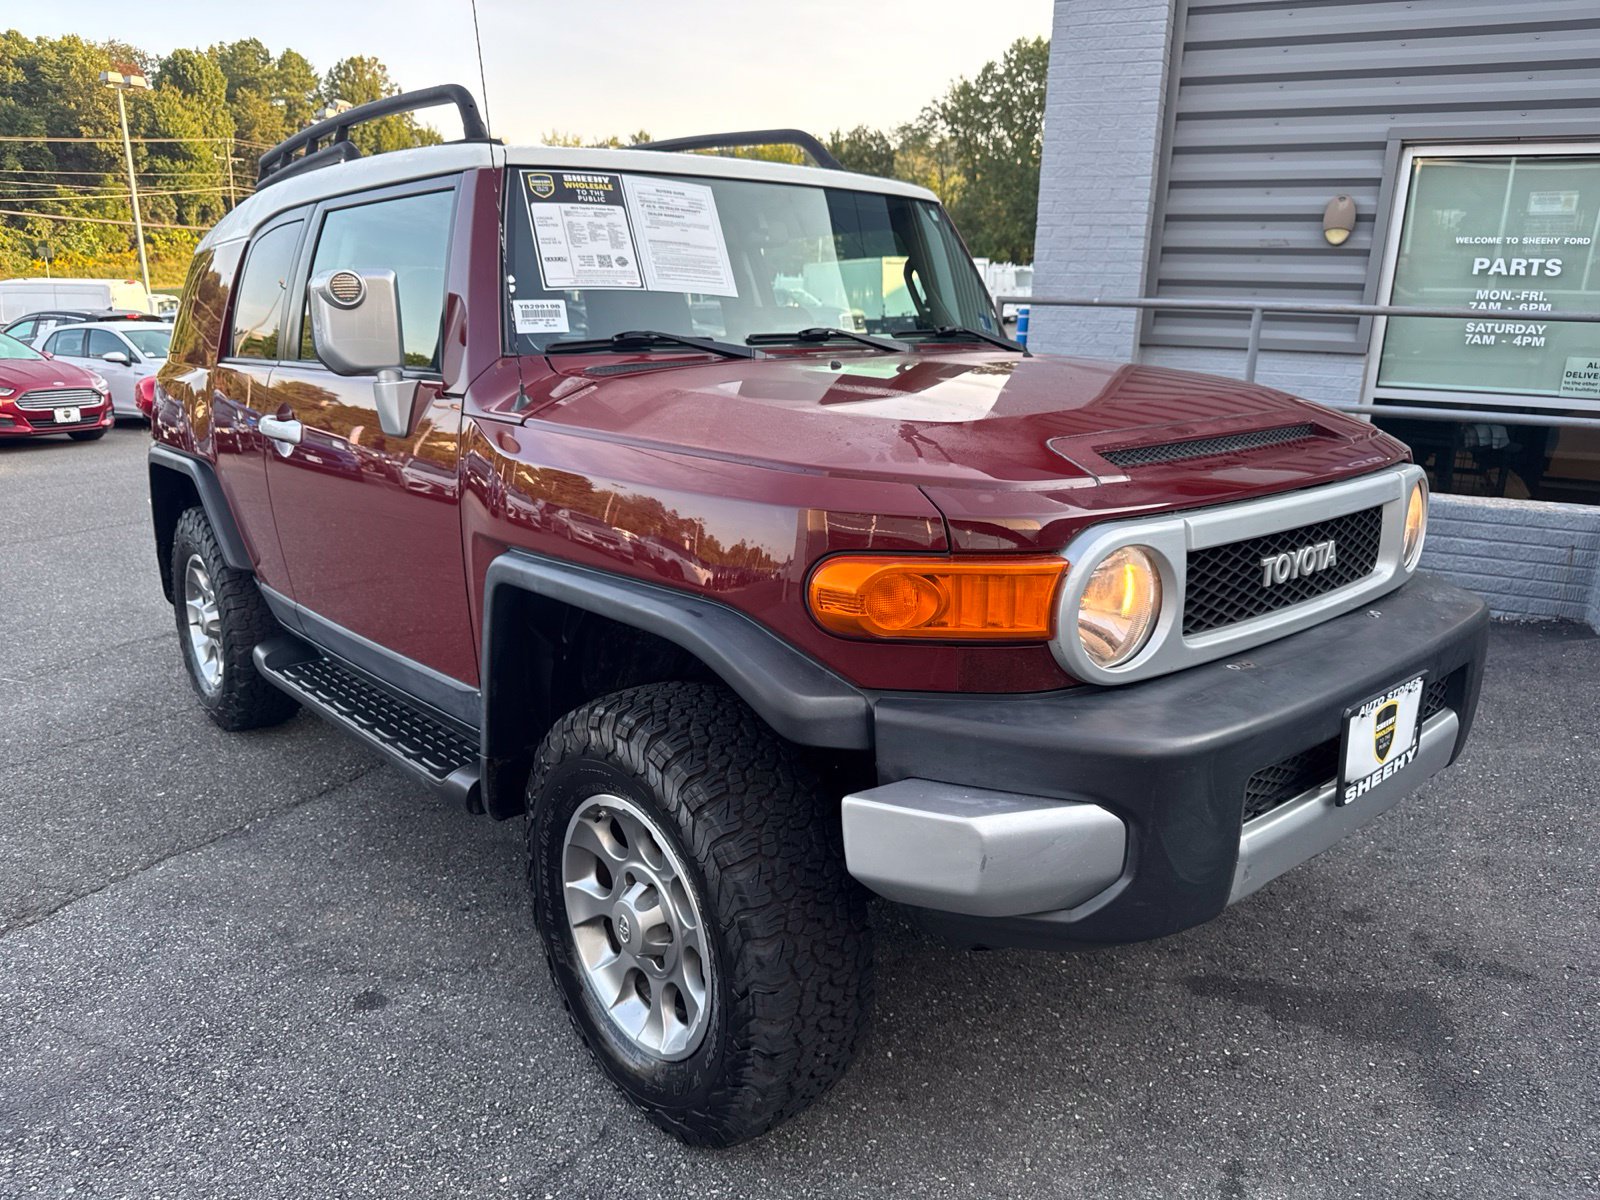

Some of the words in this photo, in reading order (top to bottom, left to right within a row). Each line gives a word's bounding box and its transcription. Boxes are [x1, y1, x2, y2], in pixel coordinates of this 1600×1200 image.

[563, 174, 609, 183] SHEEHY
[564, 182, 613, 191] WHOLESALE
[1456, 236, 1502, 244] WELCOME
[1522, 236, 1560, 244] SHEEHY
[1564, 237, 1591, 245] FORD
[1472, 257, 1562, 276] PARTS
[1469, 302, 1502, 310] 7AM
[1519, 302, 1552, 312] 6PM
[1466, 322, 1547, 335] SATURDAY
[1465, 334, 1496, 345] 7AM
[1512, 335, 1546, 347] 4PM
[1566, 370, 1600, 380] DELIVE
[1260, 540, 1337, 588] TOYOTA
[1359, 696, 1386, 718] AUTO
[1344, 746, 1418, 805] SHEEHY
